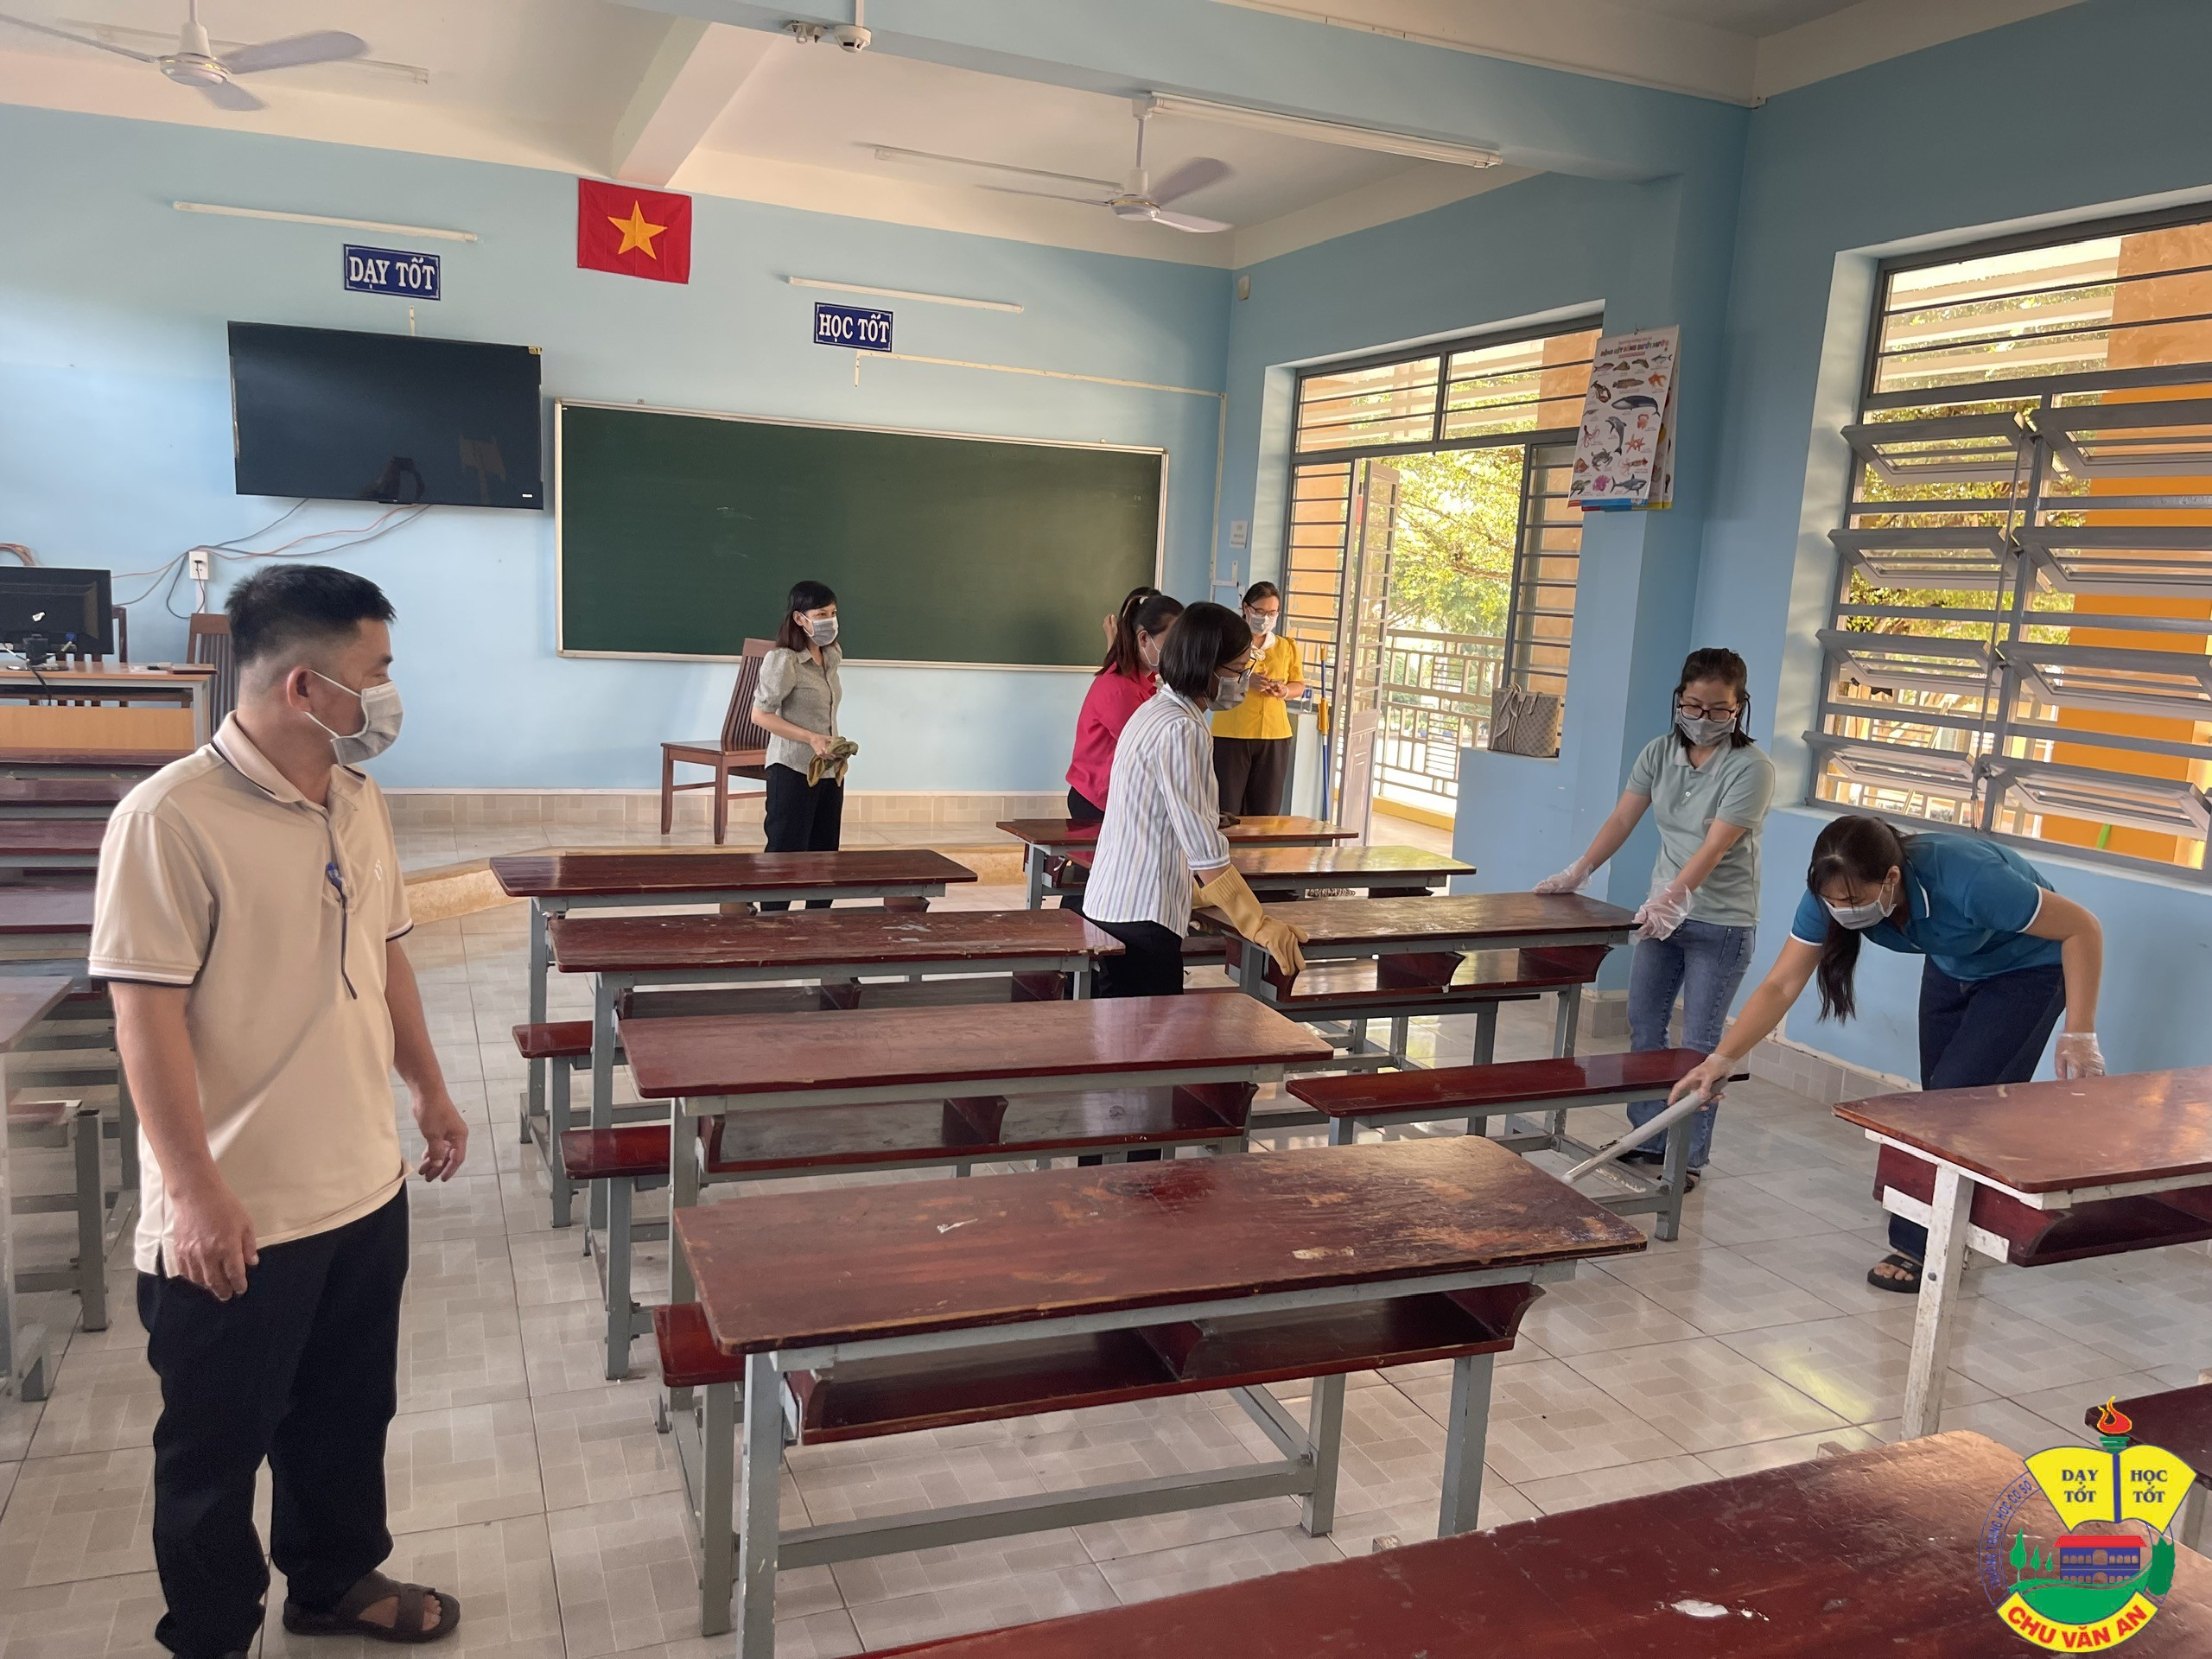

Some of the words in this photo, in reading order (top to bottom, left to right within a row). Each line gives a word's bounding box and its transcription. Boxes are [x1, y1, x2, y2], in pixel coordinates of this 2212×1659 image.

[349, 256, 391, 289] DẠY
[396, 257, 435, 290] TỐT
[818, 313, 854, 343] HỌC
[858, 313, 889, 343] TỐT
